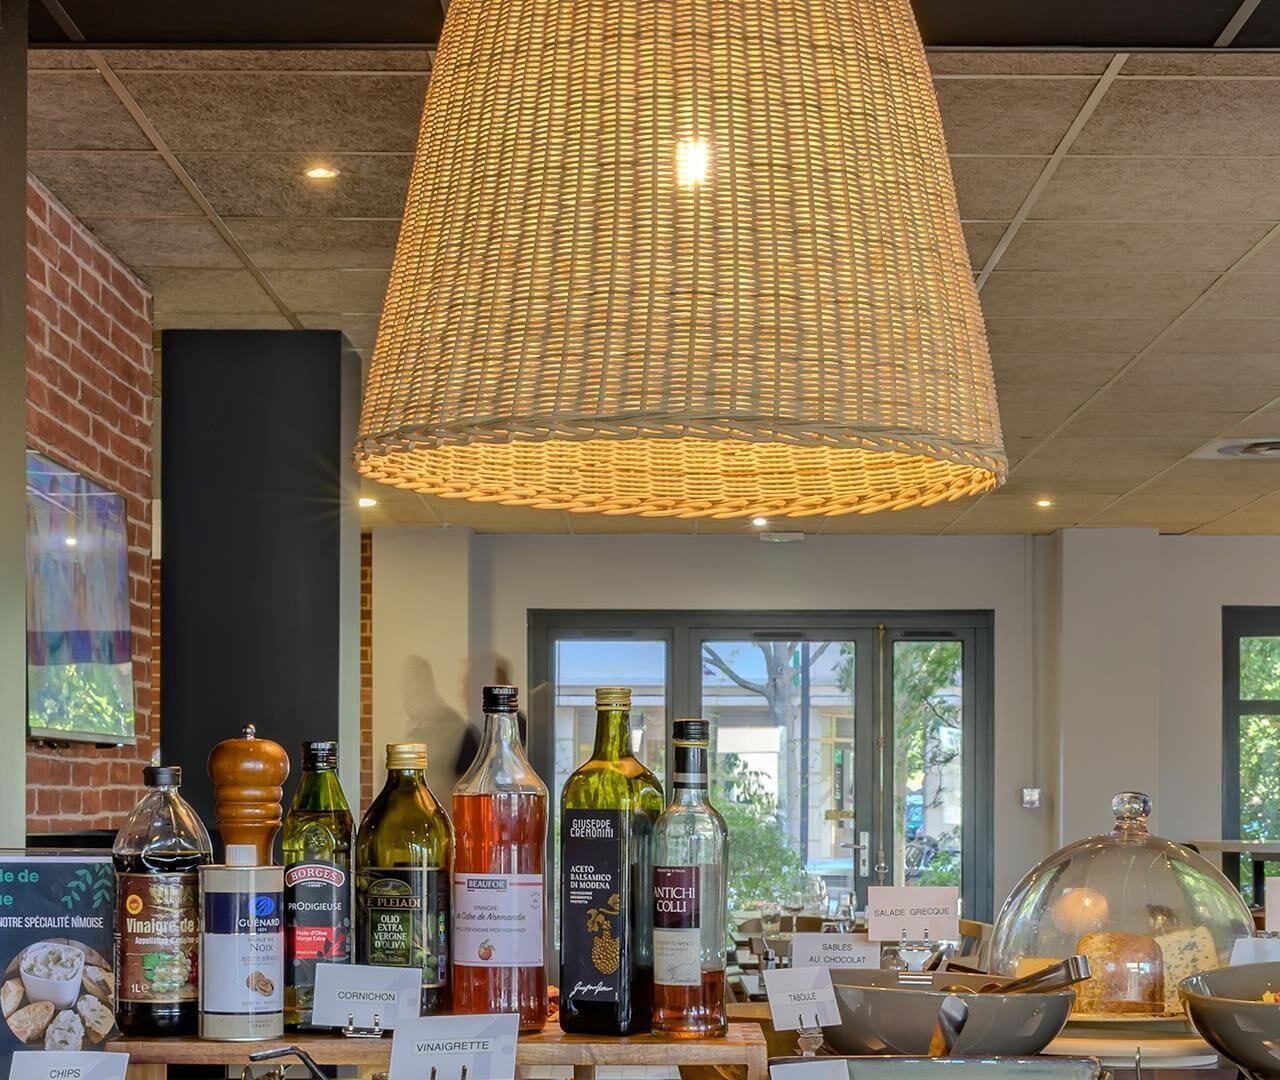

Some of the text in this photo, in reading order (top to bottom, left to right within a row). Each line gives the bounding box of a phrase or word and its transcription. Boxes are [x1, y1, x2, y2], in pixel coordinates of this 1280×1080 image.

[572, 819, 611, 829] GIUSEPPE
[570, 828, 614, 838] CREMONINI
[291, 867, 338, 881] BORGES
[570, 865, 595, 873] ACETO
[17, 868, 40, 883] de
[570, 873, 612, 882] BALSAMICO
[468, 880, 505, 888] BEAUFOR
[570, 881, 610, 890] DI MODENA
[654, 887, 696, 899] ANTICHI
[288, 901, 342, 911] PRODIGIEUSE
[377, 897, 421, 908] PLEIADI
[656, 900, 687, 912] COLLI
[874, 907, 950, 917] SALADE GRECQUE
[24, 914, 70, 929] SPÉCIALITÉ
[71, 914, 104, 929] NÎMOISE
[381, 915, 400, 923] OLIO
[126, 918, 178, 936] Vinaigre
[180, 917, 195, 933] de
[377, 923, 404, 932] EXTRA
[373, 932, 408, 940] VERGINE
[374, 940, 406, 949] D'OLIVA
[822, 943, 853, 951] SABLES
[823, 955, 867, 964] CHOCOLAT
[337, 991, 396, 1001] CORNICHON
[788, 992, 817, 1001] TABOULE
[416, 1040, 489, 1052] VINAIGRETTE
[49, 1068, 81, 1079] CHIPS
